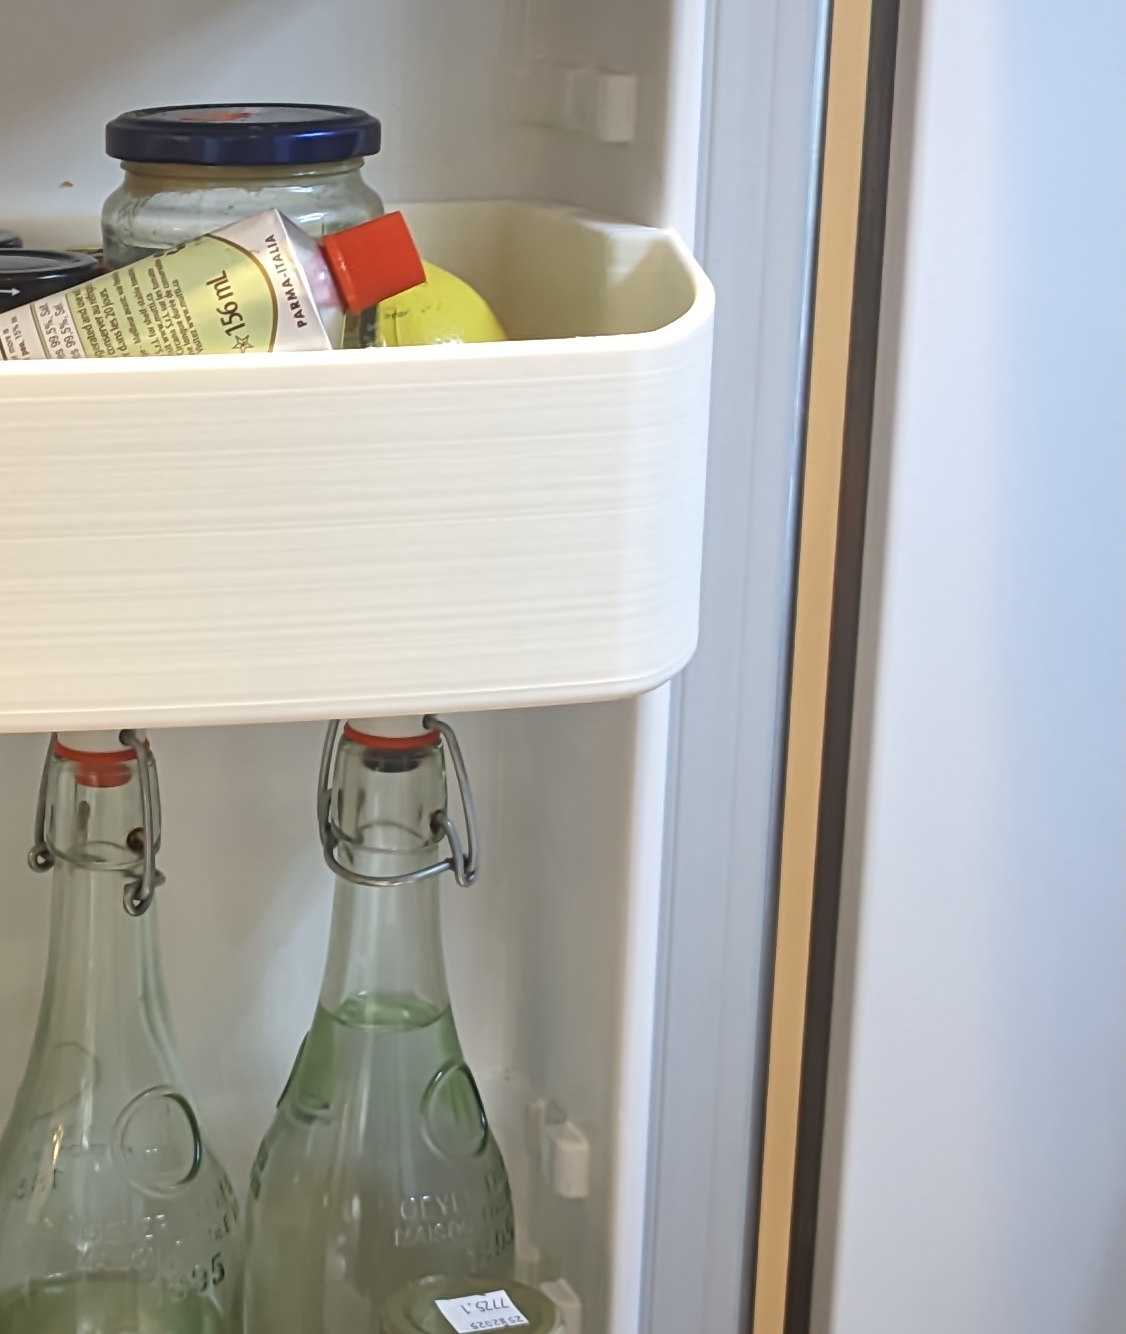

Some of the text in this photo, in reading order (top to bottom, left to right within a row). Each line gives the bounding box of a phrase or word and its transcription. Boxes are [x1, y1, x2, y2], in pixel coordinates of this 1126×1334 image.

[265, 234, 307, 328] PARMA-ITALIA
[155, 289, 163, 300] les
[164, 289, 173, 298] de
[172, 279, 194, 329] www.mutti.ca
[206, 269, 245, 336] 156 mL
[77, 308, 90, 323] and
[103, 307, 115, 318] 20
[159, 301, 167, 311] sur
[109, 317, 119, 332] les
[146, 292, 169, 343] www.mutti.ca
[95, 316, 115, 355] conserver
[114, 330, 127, 351] dans
[147, 327, 156, 337] for
[170, 329, 184, 355] Circana
[176, 320, 190, 346] longue
